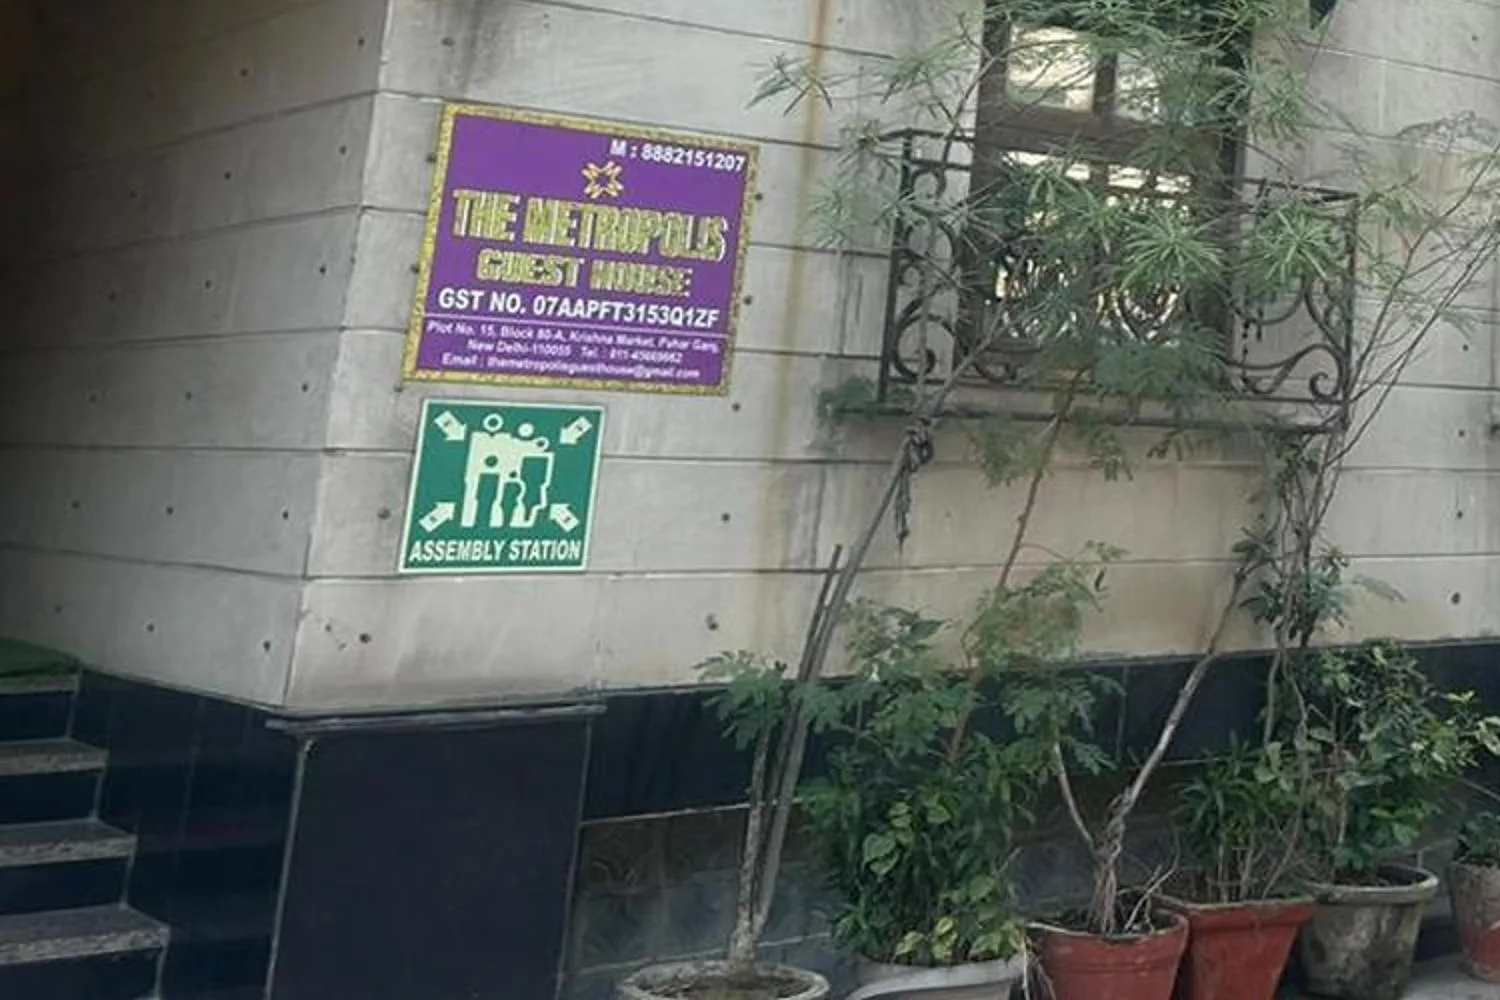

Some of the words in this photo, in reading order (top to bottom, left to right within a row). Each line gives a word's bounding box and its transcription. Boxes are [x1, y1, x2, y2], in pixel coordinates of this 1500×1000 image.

[610, 139, 627, 157] M
[453, 189, 521, 242] THE
[523, 197, 729, 262] METROPOLIS
[476, 248, 585, 288] GUEST
[438, 287, 484, 310] GST
[489, 292, 526, 315] NO.
[409, 540, 505, 562] ASSEMBLY
[508, 540, 582, 561] STATION
